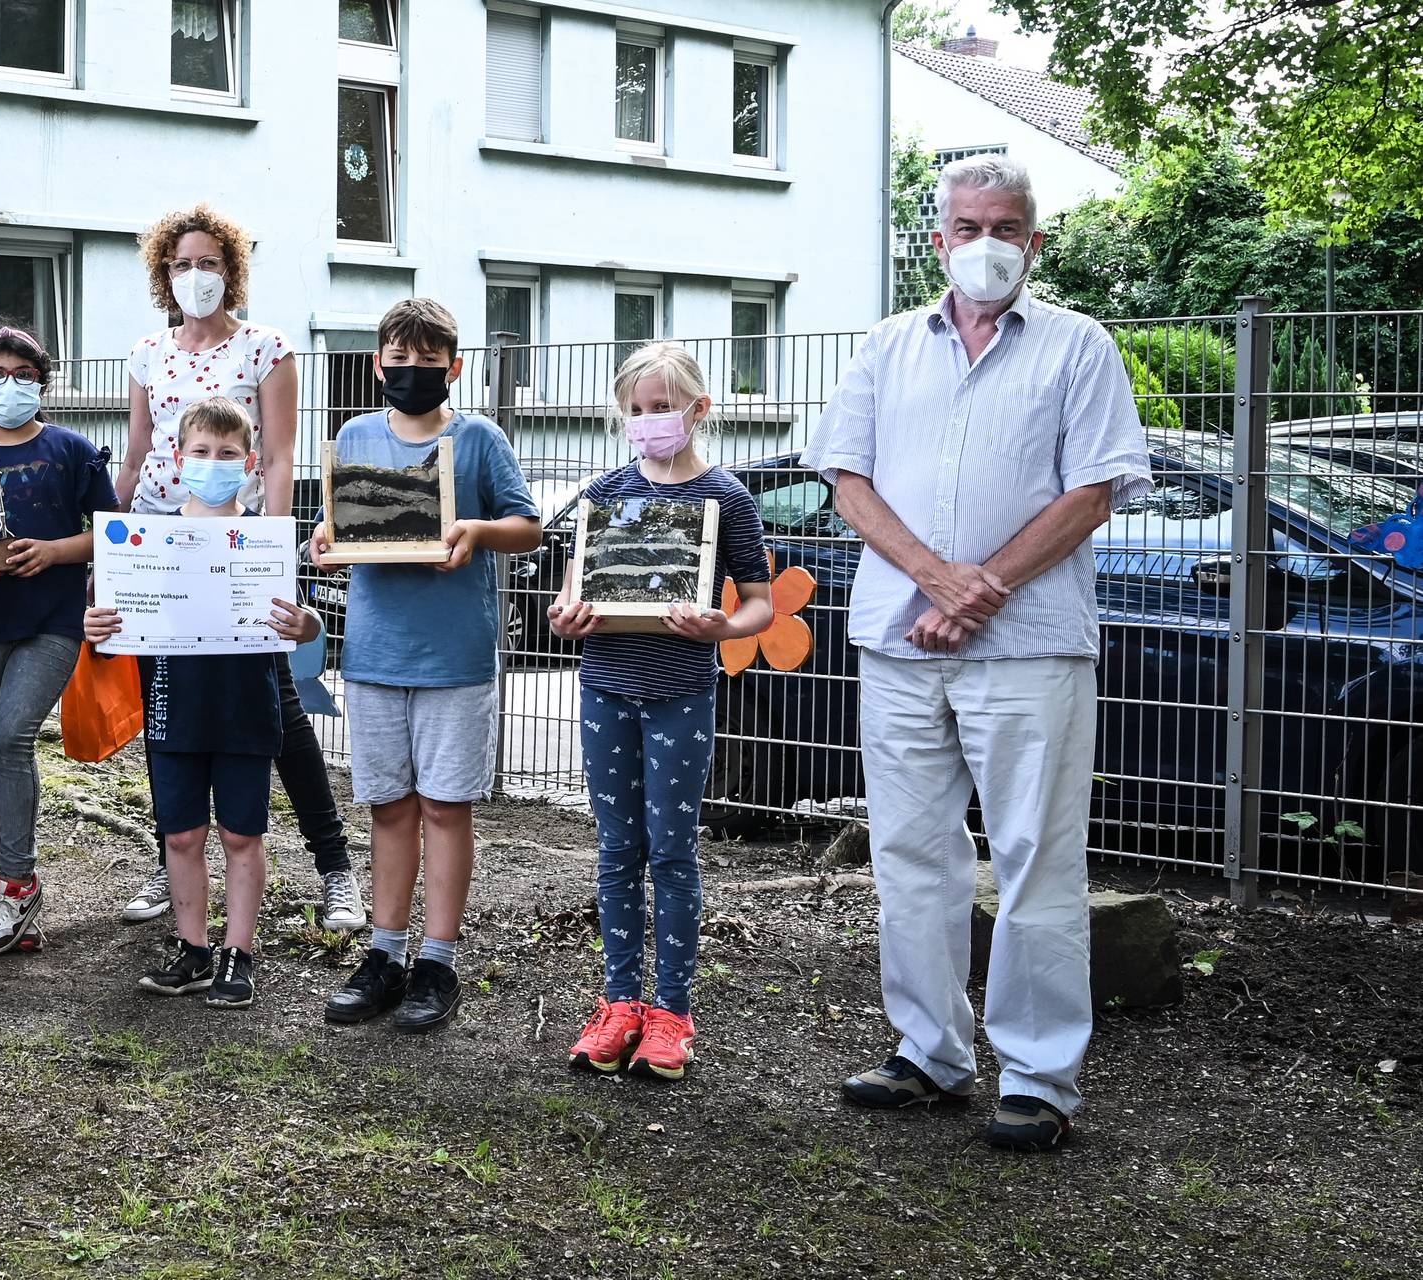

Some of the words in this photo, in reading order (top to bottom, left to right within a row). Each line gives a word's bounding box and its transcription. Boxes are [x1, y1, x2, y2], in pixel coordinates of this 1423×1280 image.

[133, 563, 180, 571] fünftausend
[115, 591, 150, 599] Grundschule
[115, 598, 148, 606] Unterstraße
